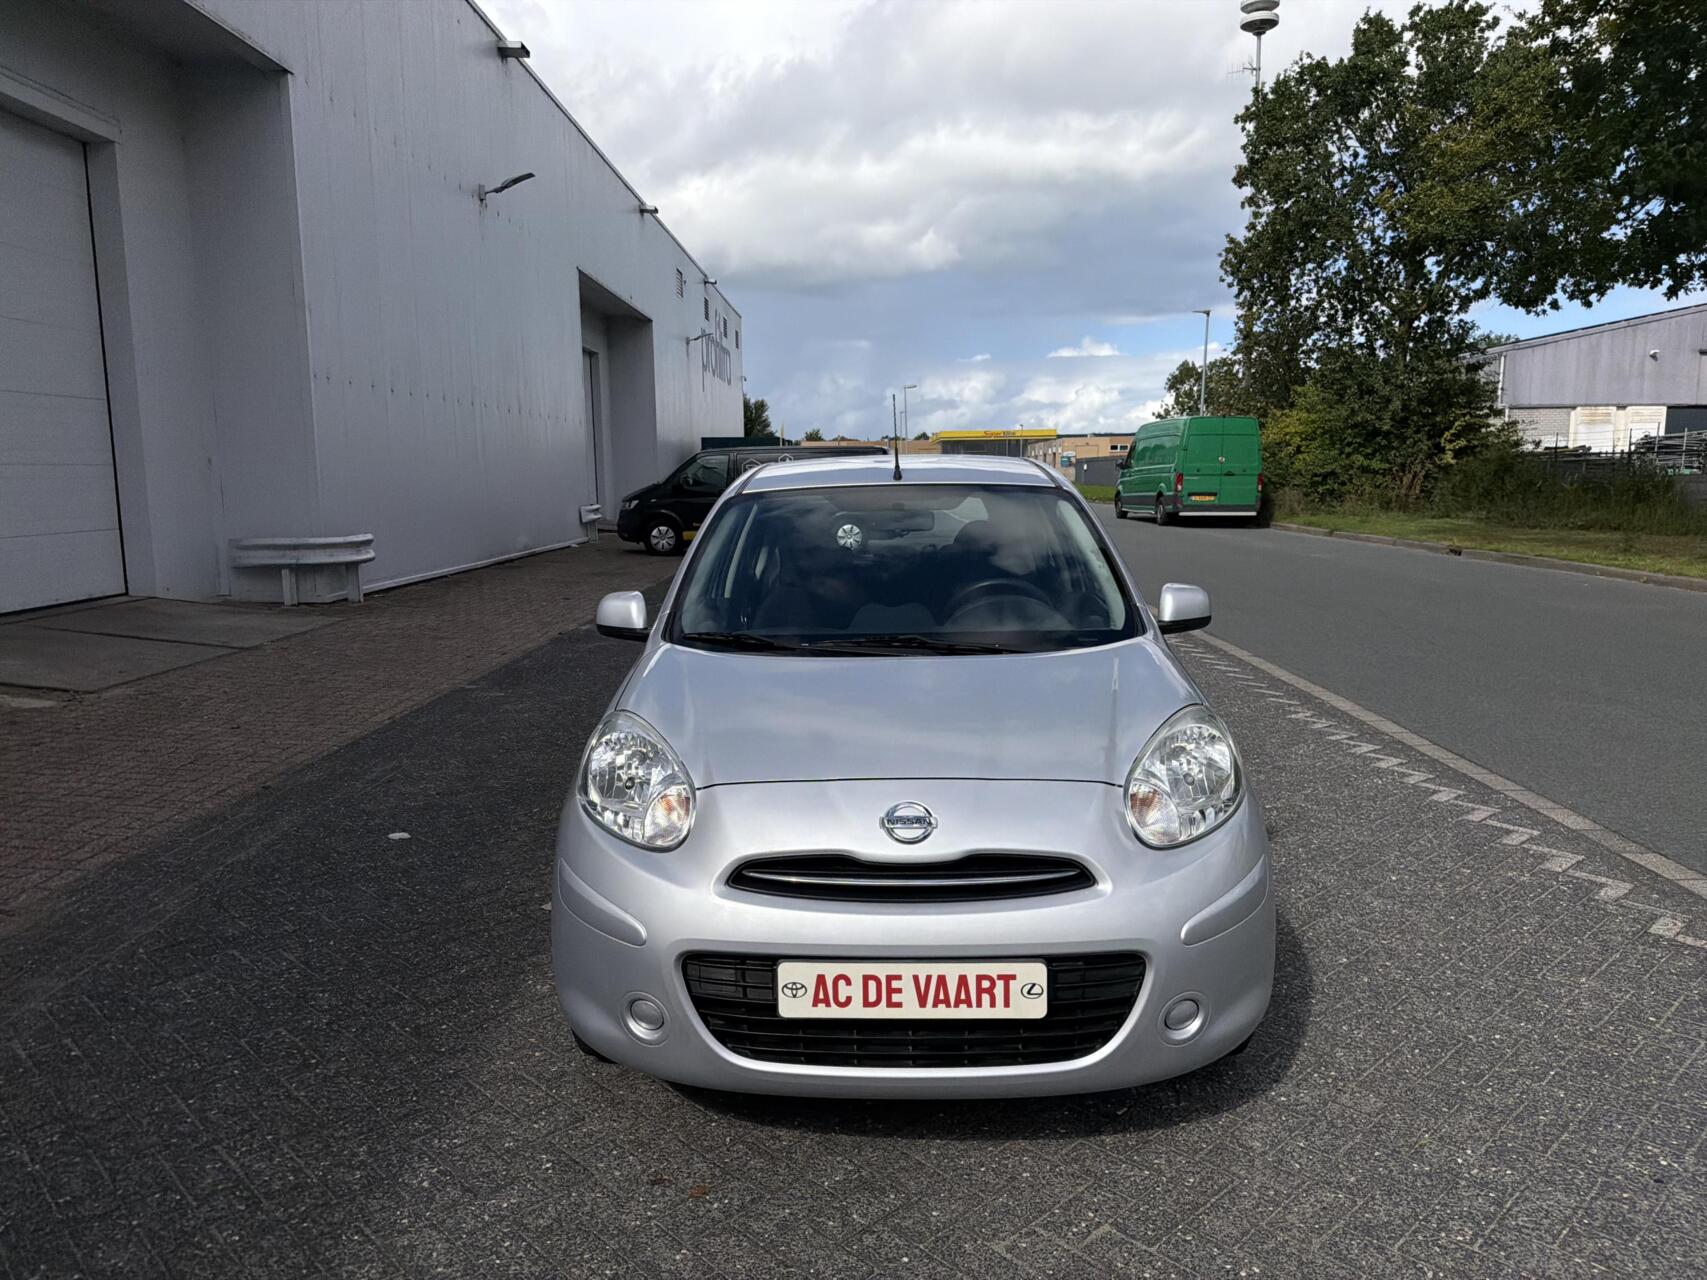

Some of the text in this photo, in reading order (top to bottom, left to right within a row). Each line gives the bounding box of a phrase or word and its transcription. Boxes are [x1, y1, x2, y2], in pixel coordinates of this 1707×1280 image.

[811, 973, 1017, 1009] AC DE VAART
